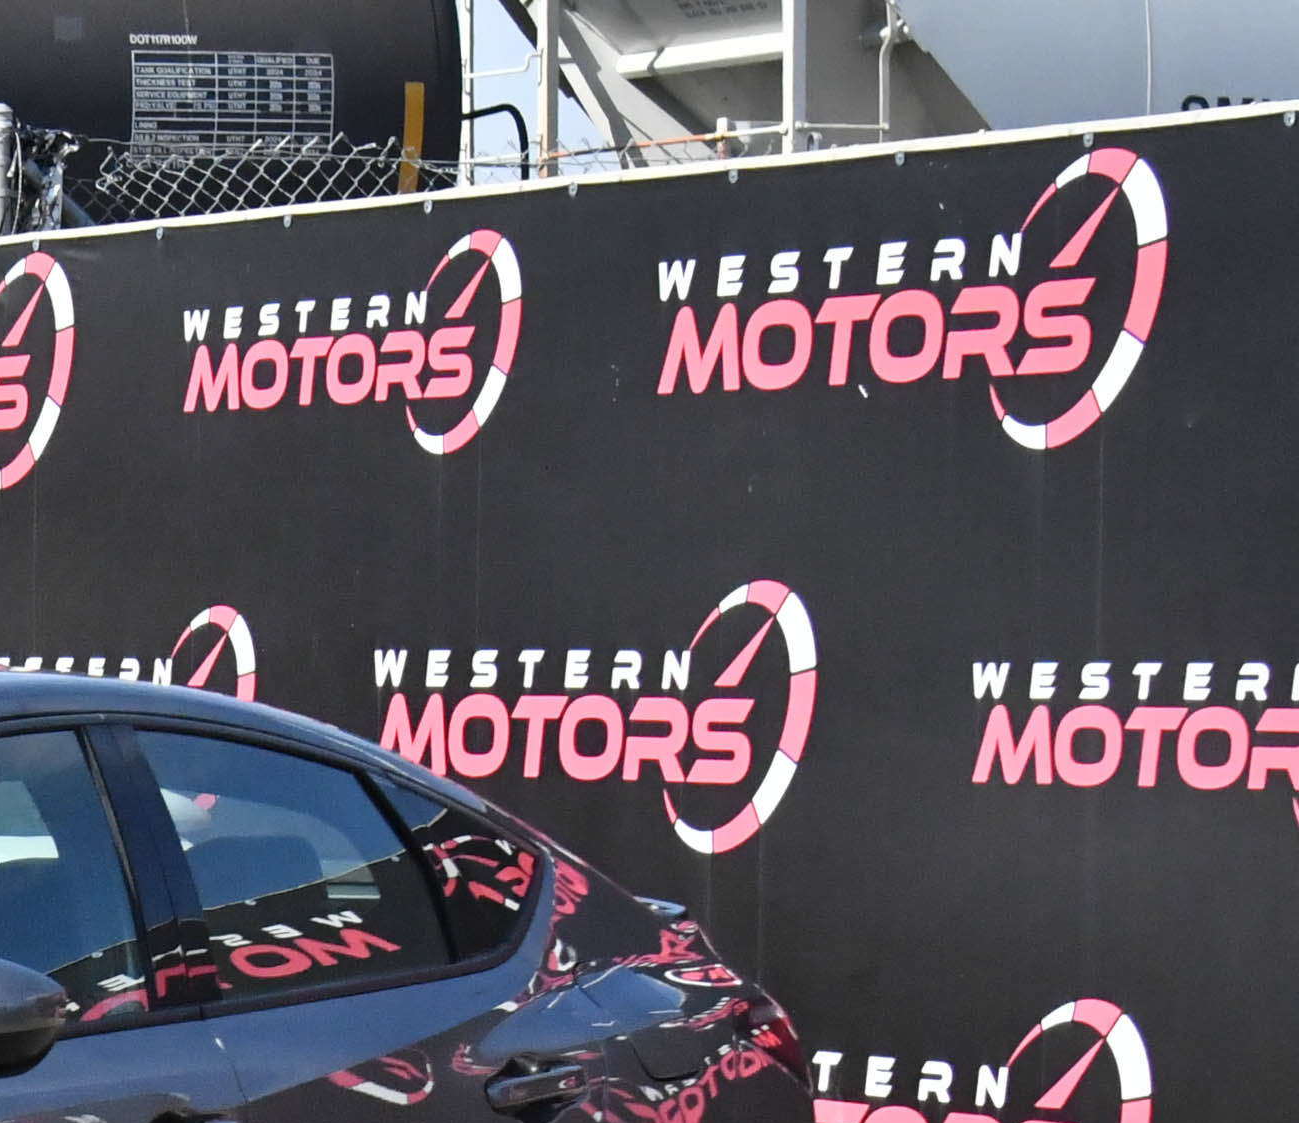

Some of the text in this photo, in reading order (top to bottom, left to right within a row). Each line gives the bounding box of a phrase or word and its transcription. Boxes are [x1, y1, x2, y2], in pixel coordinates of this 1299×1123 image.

[659, 232, 1023, 301] WESTERN
[184, 289, 428, 342] WESTERN
[657, 277, 1097, 395] MOTORS
[183, 326, 476, 412] MOTORS
[373, 649, 692, 690] WESTERN
[379, 691, 756, 785] MOTORS
